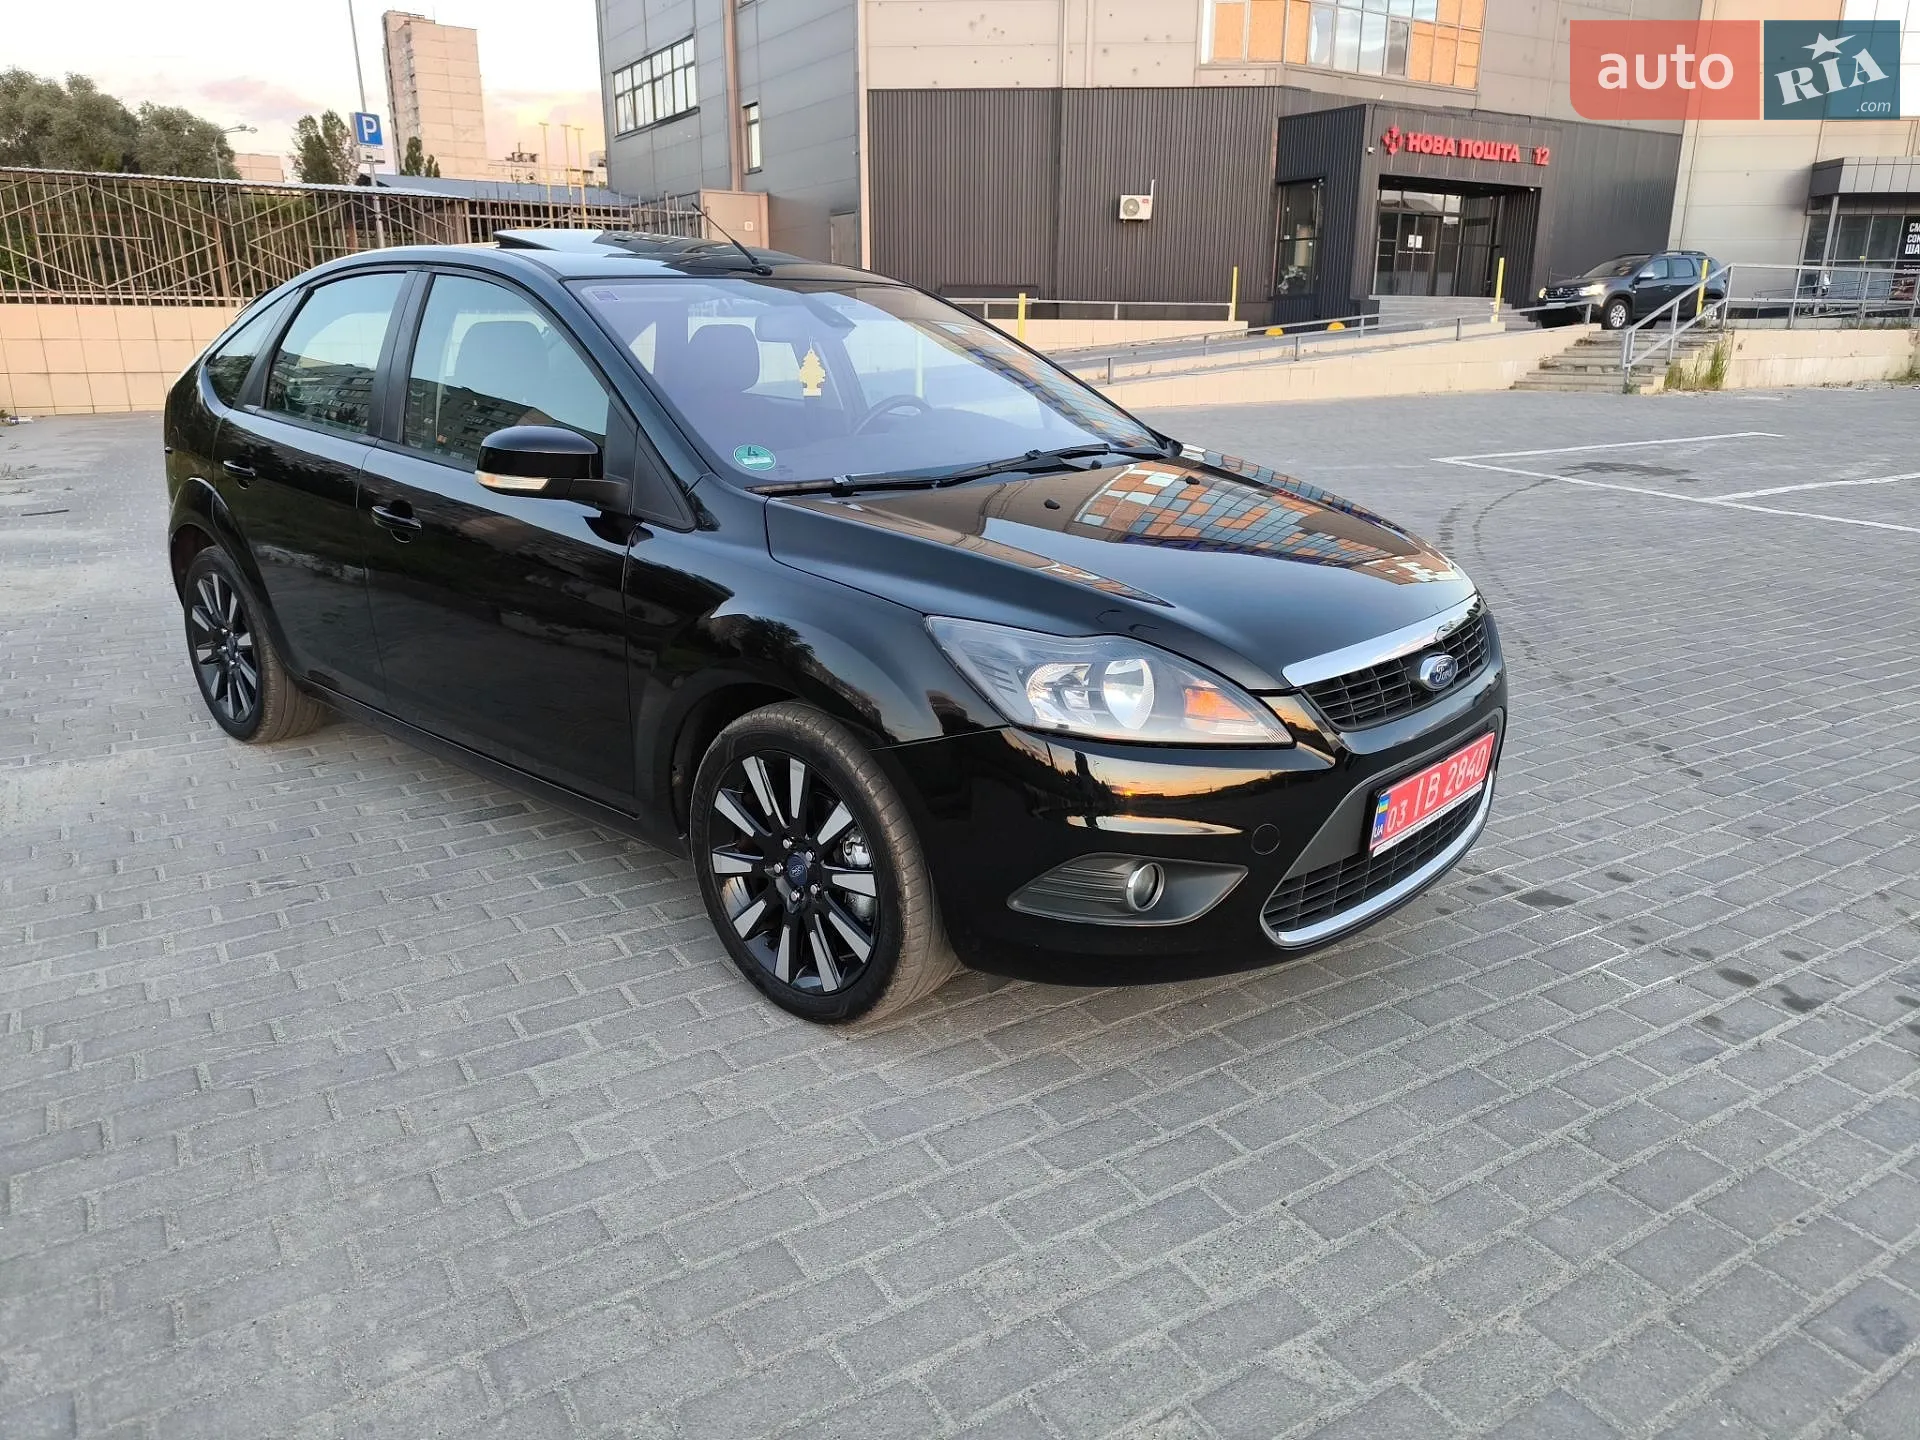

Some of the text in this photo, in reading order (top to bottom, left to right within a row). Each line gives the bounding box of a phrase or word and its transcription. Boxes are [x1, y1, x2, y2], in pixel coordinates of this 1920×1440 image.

[361, 115, 377, 141] P
[1406, 131, 1550, 166] НОВА ПОШТА 12
[1387, 799, 1408, 833] 03
[1443, 743, 1487, 799] 2840
[1373, 824, 1384, 838] UA
